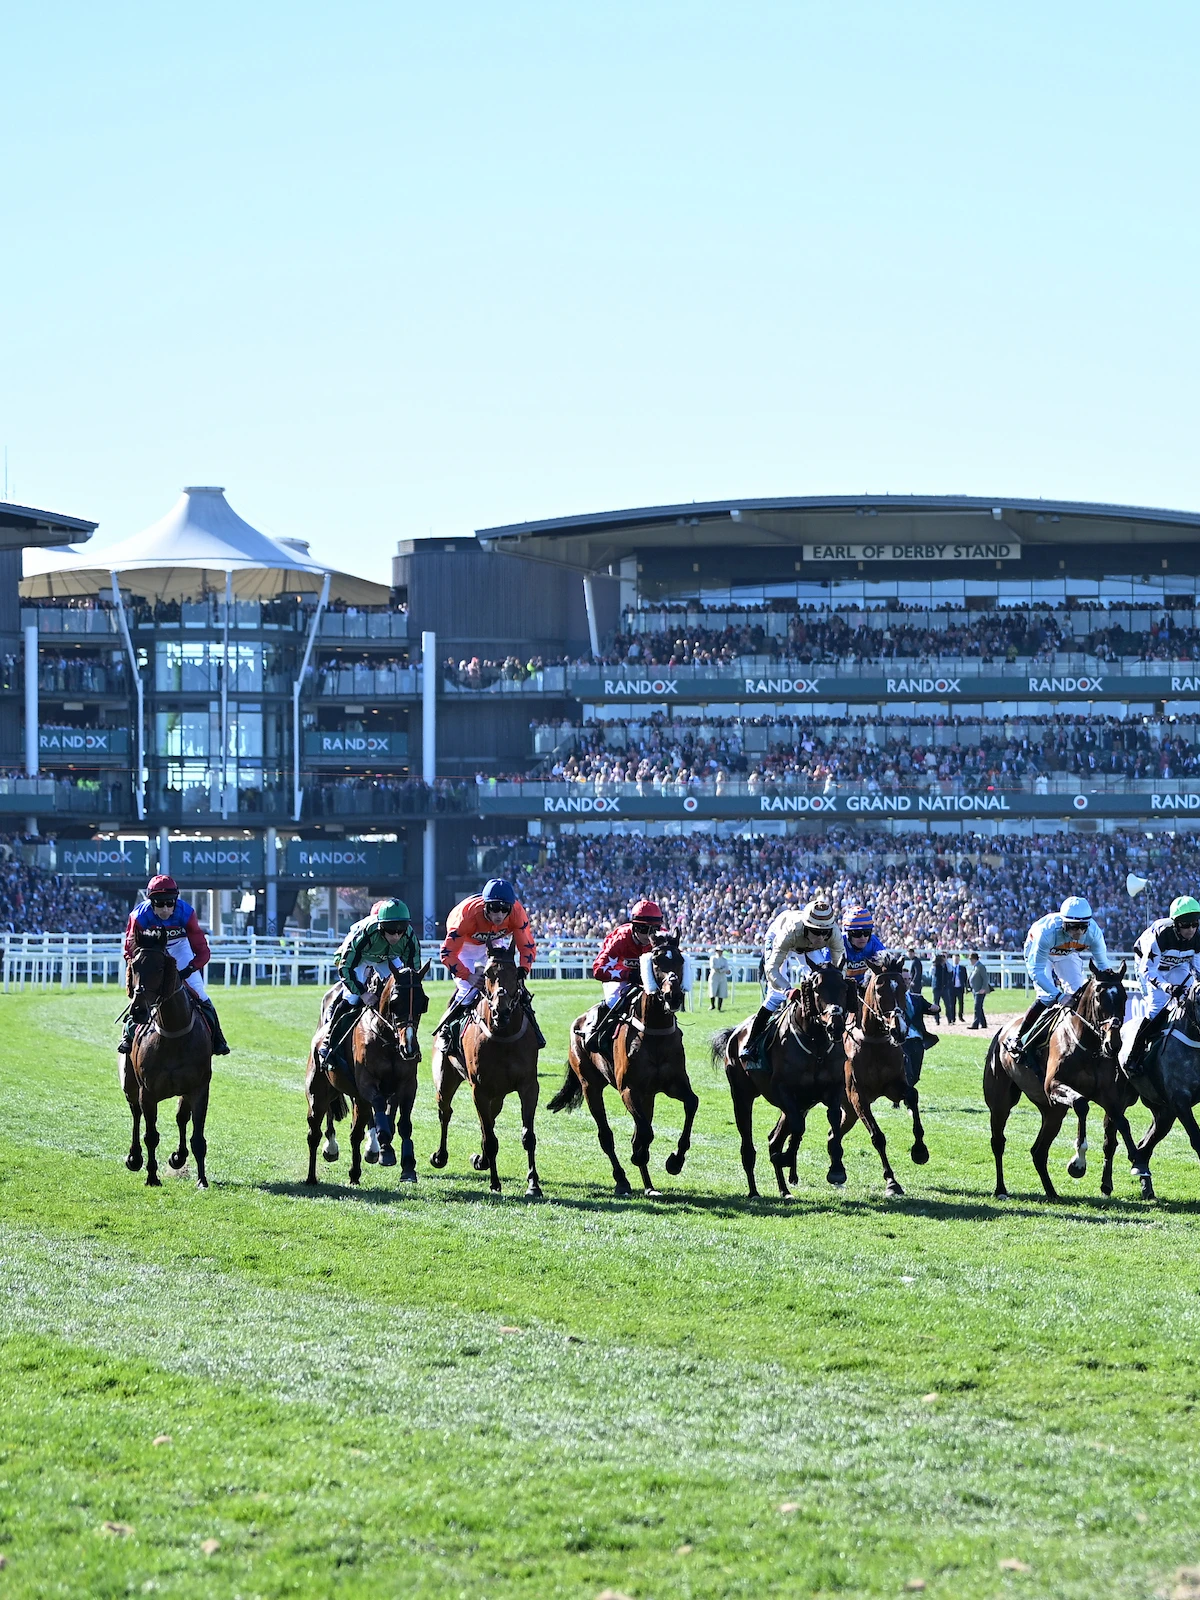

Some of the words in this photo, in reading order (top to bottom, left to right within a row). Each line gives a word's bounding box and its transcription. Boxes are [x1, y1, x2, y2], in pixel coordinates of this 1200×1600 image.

[812, 545, 856, 559] EARL
[862, 545, 885, 558] OF
[892, 545, 950, 559] DERBY
[954, 544, 1010, 558] STAND
[605, 680, 678, 694] RANDOX
[745, 679, 819, 693] RANDOX
[887, 679, 961, 693] RANDOX
[1029, 677, 1103, 691] RANDOX
[40, 736, 107, 748] RANDOX
[323, 738, 388, 750] RANDOX
[544, 797, 620, 812] RANDOX
[761, 796, 836, 811] RANDOX
[846, 796, 911, 811] GRAND
[918, 795, 1010, 811] NATIONAL
[64, 851, 132, 863] RANDOX
[182, 851, 250, 863] RANDOX
[300, 852, 366, 864] RANDOX
